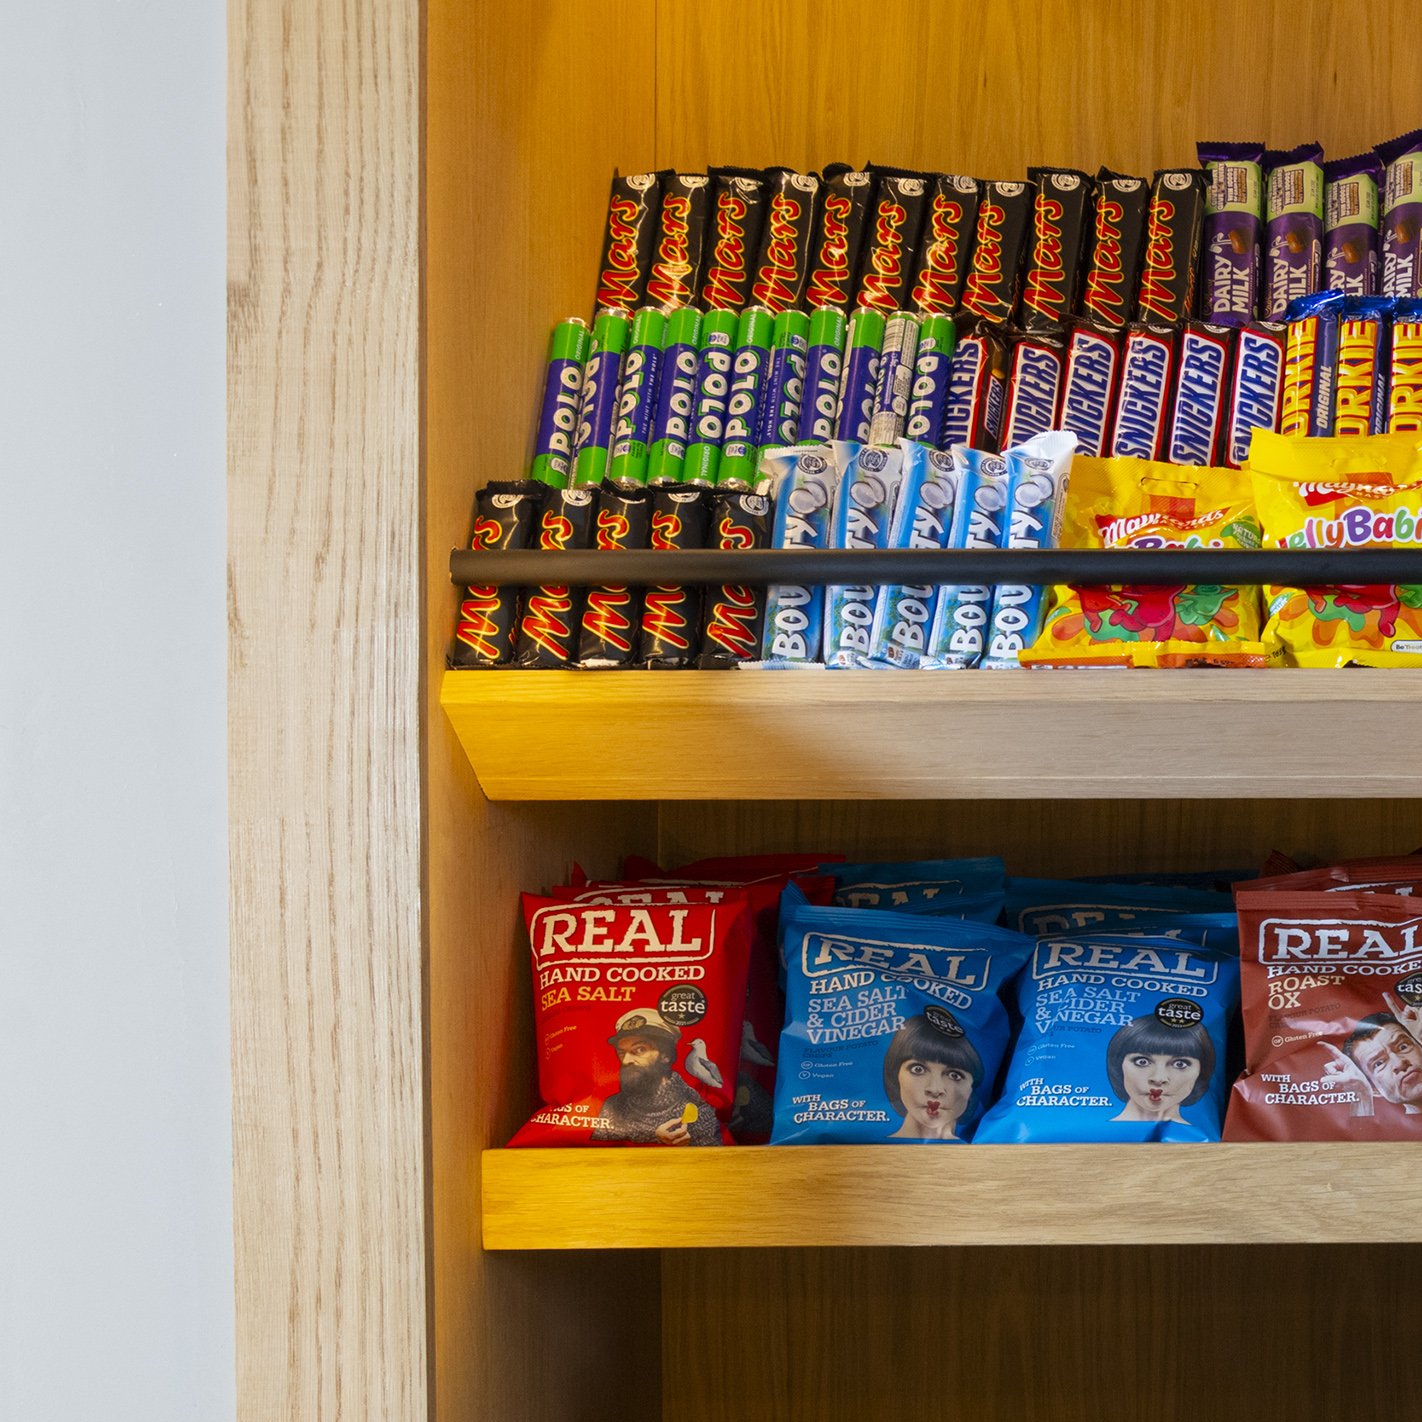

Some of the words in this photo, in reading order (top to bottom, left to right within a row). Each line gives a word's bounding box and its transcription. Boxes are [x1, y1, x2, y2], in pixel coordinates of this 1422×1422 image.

[1084, 195, 1125, 326] Mars
[1138, 195, 1178, 323] Mars
[1214, 255, 1232, 313] DAIRY
[1232, 267, 1249, 314] MILK
[549, 366, 584, 455] POLO
[726, 350, 760, 439] POLO
[1172, 338, 1225, 466] SNICKERS
[1316, 365, 1332, 429] ORIGINAL
[539, 908, 703, 956] REAL
[814, 936, 977, 986] REAL
[1043, 942, 1206, 977] REAL
[1267, 964, 1337, 979] HAND
[539, 966, 589, 987] HAND
[610, 965, 705, 982] COOKED
[1267, 974, 1345, 997] ROAST
[541, 988, 572, 1012] SEA
[577, 986, 636, 1002] SALT
[807, 993, 851, 1013] SEA
[857, 985, 907, 1003] SALT
[807, 1012, 825, 1027] &
[833, 1002, 898, 1024] CIDER
[1268, 992, 1302, 1011] OX
[807, 1016, 907, 1045] VINEGAR
[792, 1094, 821, 1105] WITH
[808, 1099, 848, 1111] BAGS
[851, 1099, 866, 1108] OF
[793, 1109, 891, 1124] CHARACTER.
